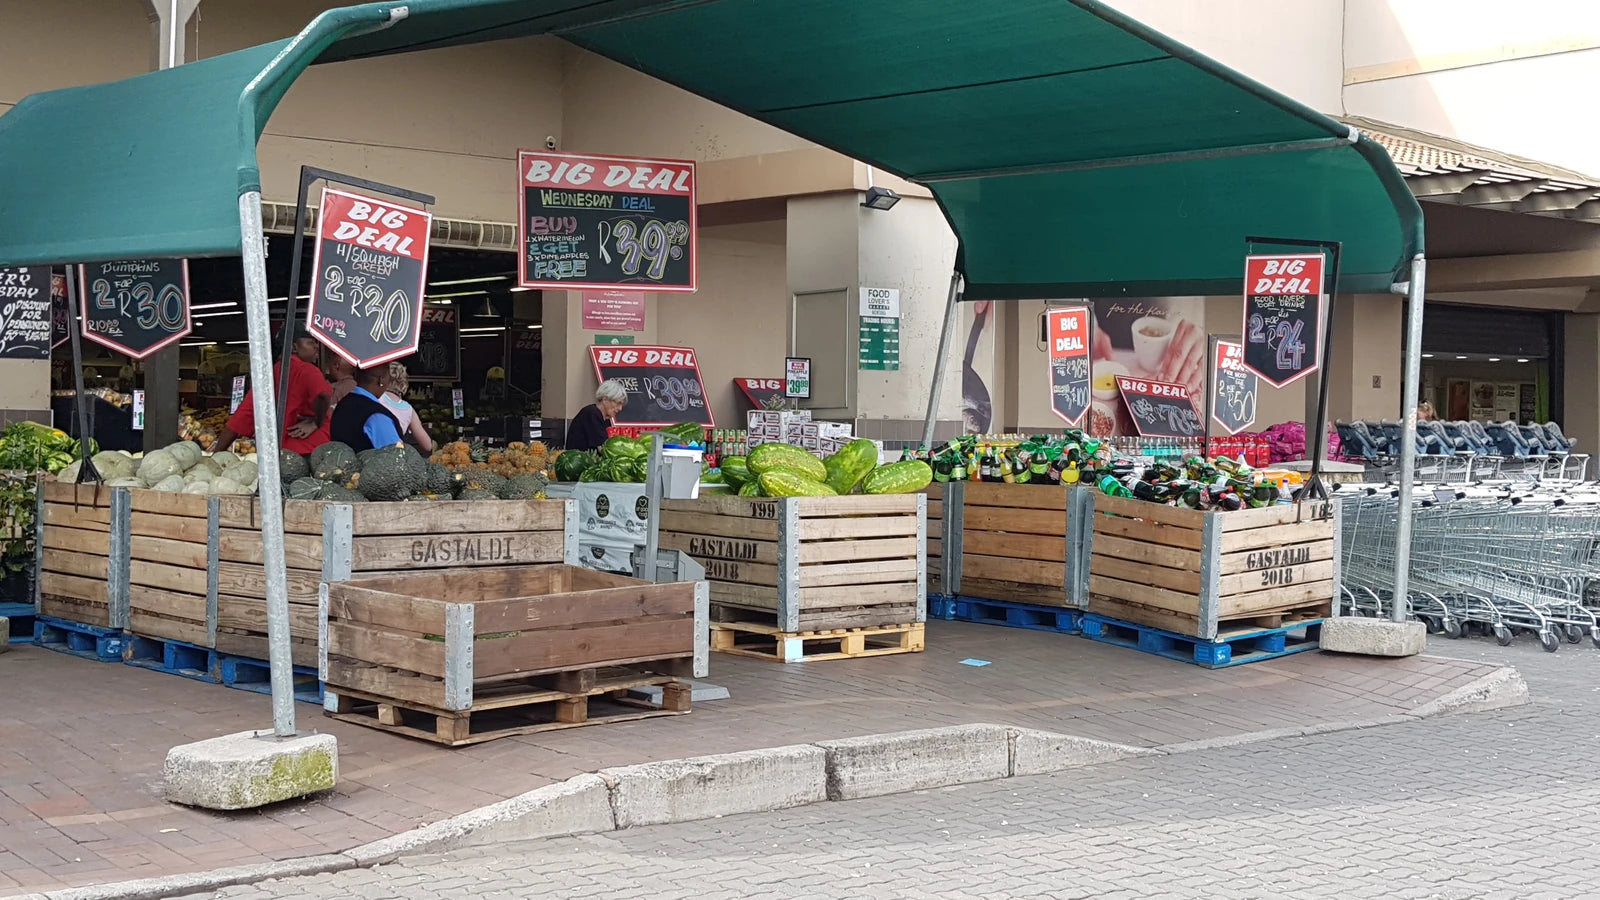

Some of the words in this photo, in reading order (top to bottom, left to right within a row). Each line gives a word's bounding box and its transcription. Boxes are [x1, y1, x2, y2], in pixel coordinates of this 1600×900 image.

[525, 160, 595, 185] BIG
[603, 165, 690, 192] DEAL
[541, 189, 614, 208] WEDNESDAY
[622, 196, 656, 210] DEAL
[347, 201, 408, 228] BIG
[530, 216, 578, 235] BUY
[333, 221, 414, 256] DEAL
[543, 241, 580, 254] GET
[352, 261, 392, 277] GREEN
[534, 260, 587, 280] FREE
[1262, 259, 1306, 275] BIG
[324, 265, 344, 302] 2
[347, 276, 367, 288] FOR
[1254, 278, 1311, 294] DEAL
[92, 278, 117, 309] 2
[114, 279, 134, 288] FOR
[868, 289, 890, 299] FOOD
[16, 300, 50, 311] DISCOUNT
[1106, 303, 1126, 318] for
[1128, 302, 1144, 314] the
[21, 310, 42, 320] FOR
[1060, 316, 1078, 331] BIG
[1249, 313, 1266, 343] 2
[1056, 336, 1084, 351] DEAL
[598, 350, 639, 365] BIG
[645, 351, 695, 367] DEAL
[745, 379, 781, 390] BIG
[1121, 380, 1147, 392] BIG
[1151, 384, 1188, 398] DEAL
[1219, 380, 1226, 397] 2
[750, 501, 776, 518] T99
[411, 537, 515, 563] GASTALDI
[689, 537, 758, 559] GASTALDI
[1246, 547, 1310, 569] GASTALDI
[705, 560, 739, 580] 2018
[1261, 568, 1293, 586] 2018
